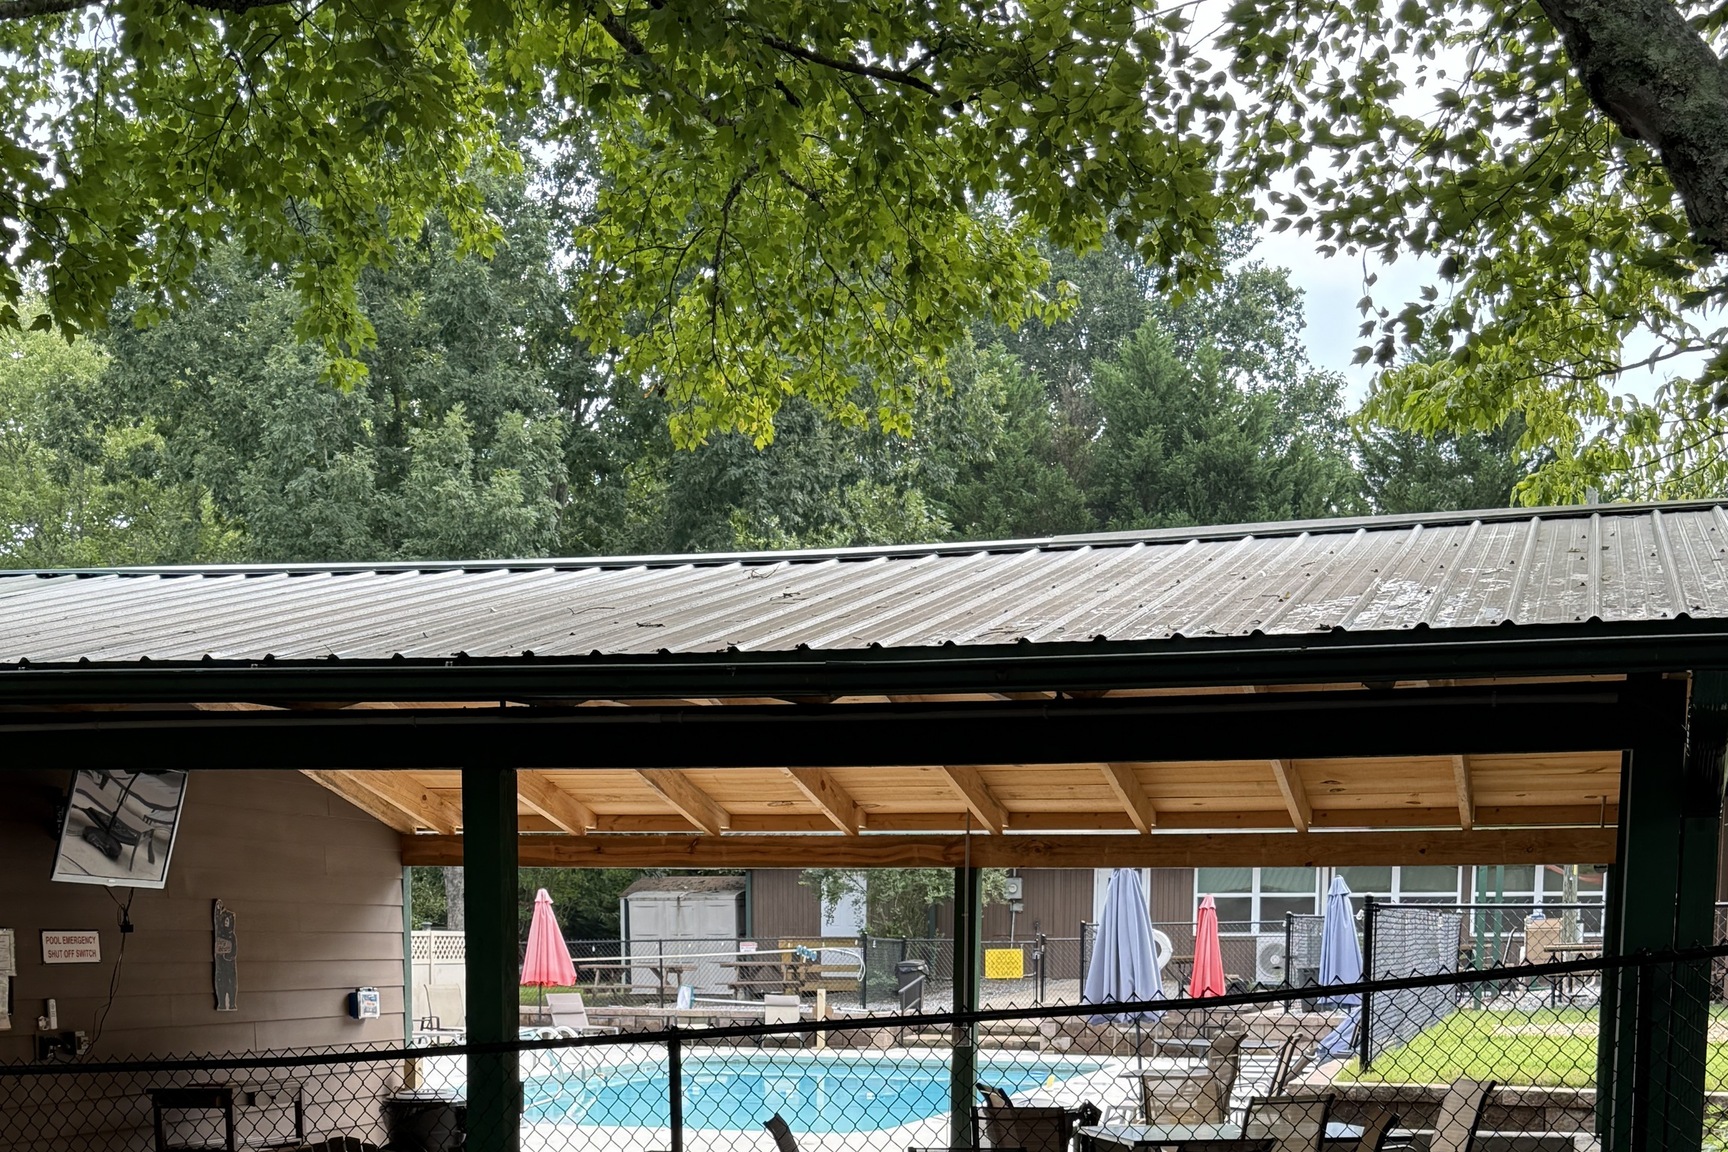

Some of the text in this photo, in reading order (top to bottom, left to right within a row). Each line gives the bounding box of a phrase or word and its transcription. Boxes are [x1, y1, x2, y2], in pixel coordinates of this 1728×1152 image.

[45, 936, 96, 945] POOL EMERGENCY
[48, 949, 97, 958] SHUT OFF SWITCH
